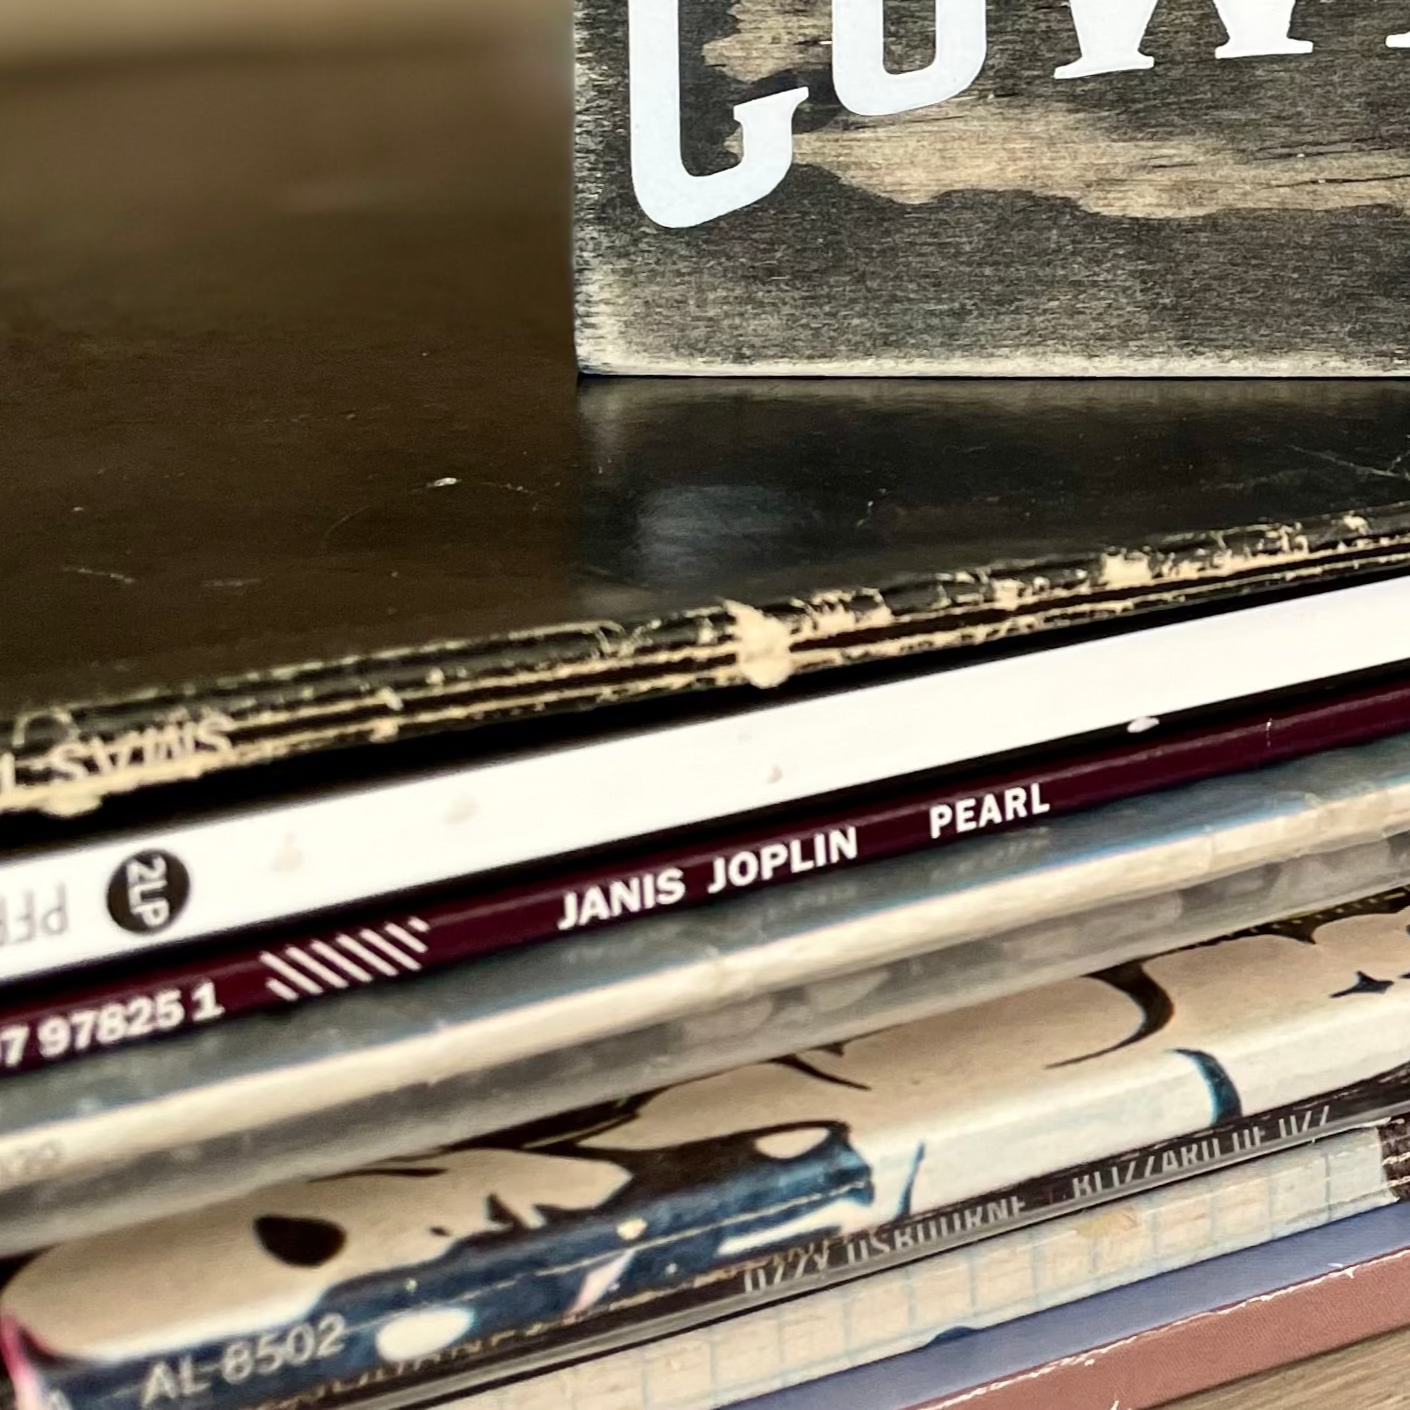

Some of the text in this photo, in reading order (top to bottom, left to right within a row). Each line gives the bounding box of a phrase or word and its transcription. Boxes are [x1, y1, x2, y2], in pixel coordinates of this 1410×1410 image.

[126, 854, 170, 928] 2LP
[557, 867, 686, 931] JANIS
[706, 826, 858, 894] JOPLIN
[928, 783, 1051, 839] PEARL
[37, 988, 186, 1058] 97825
[191, 976, 226, 1022] 1
[141, 1312, 346, 1409] AL-8502
